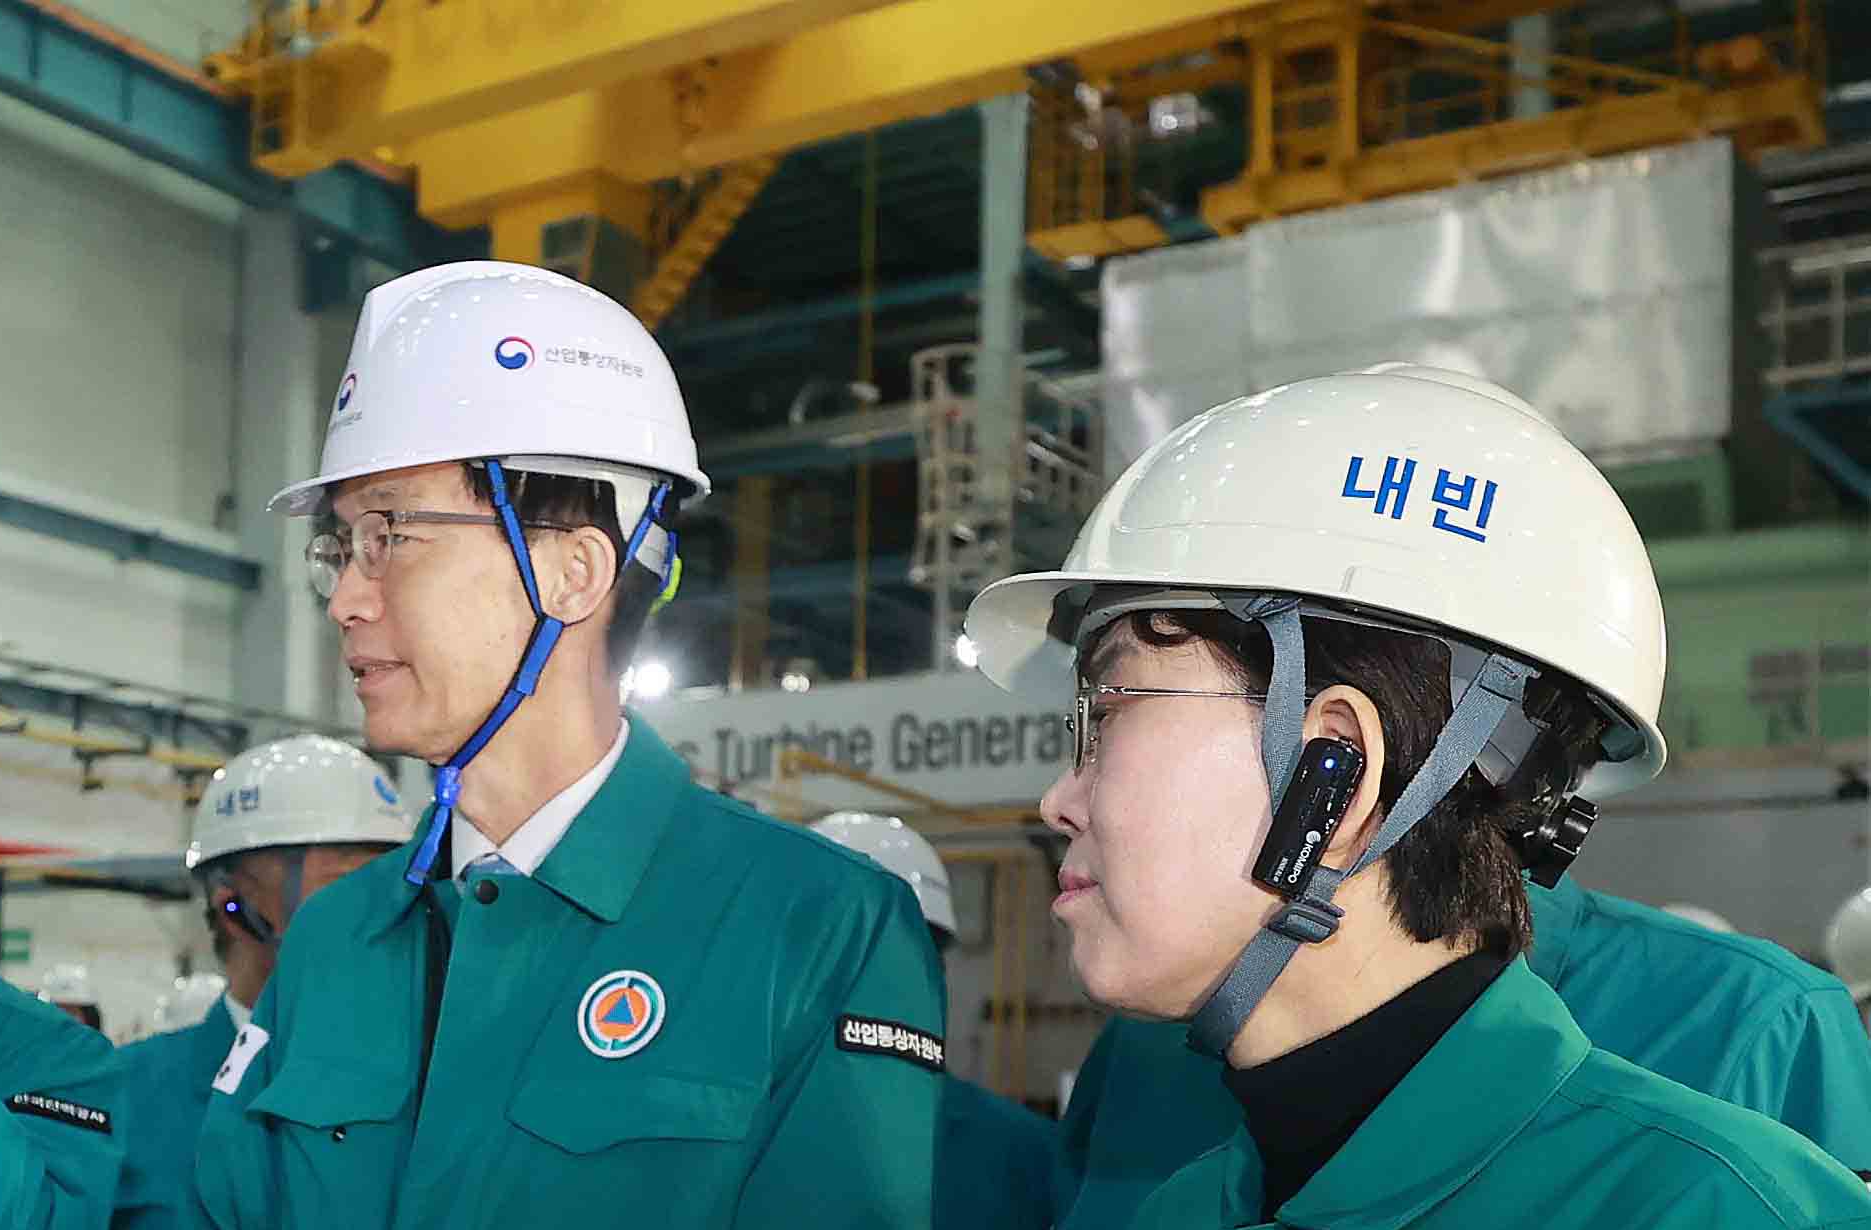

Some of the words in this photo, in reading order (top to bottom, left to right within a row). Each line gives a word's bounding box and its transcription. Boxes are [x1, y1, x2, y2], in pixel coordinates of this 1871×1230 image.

[1342, 456, 1498, 543] 내빈
[891, 713, 1064, 772] Genera
[1288, 843, 1314, 884] KOMIPO
[844, 1020, 944, 1064] 산업통상자원부
